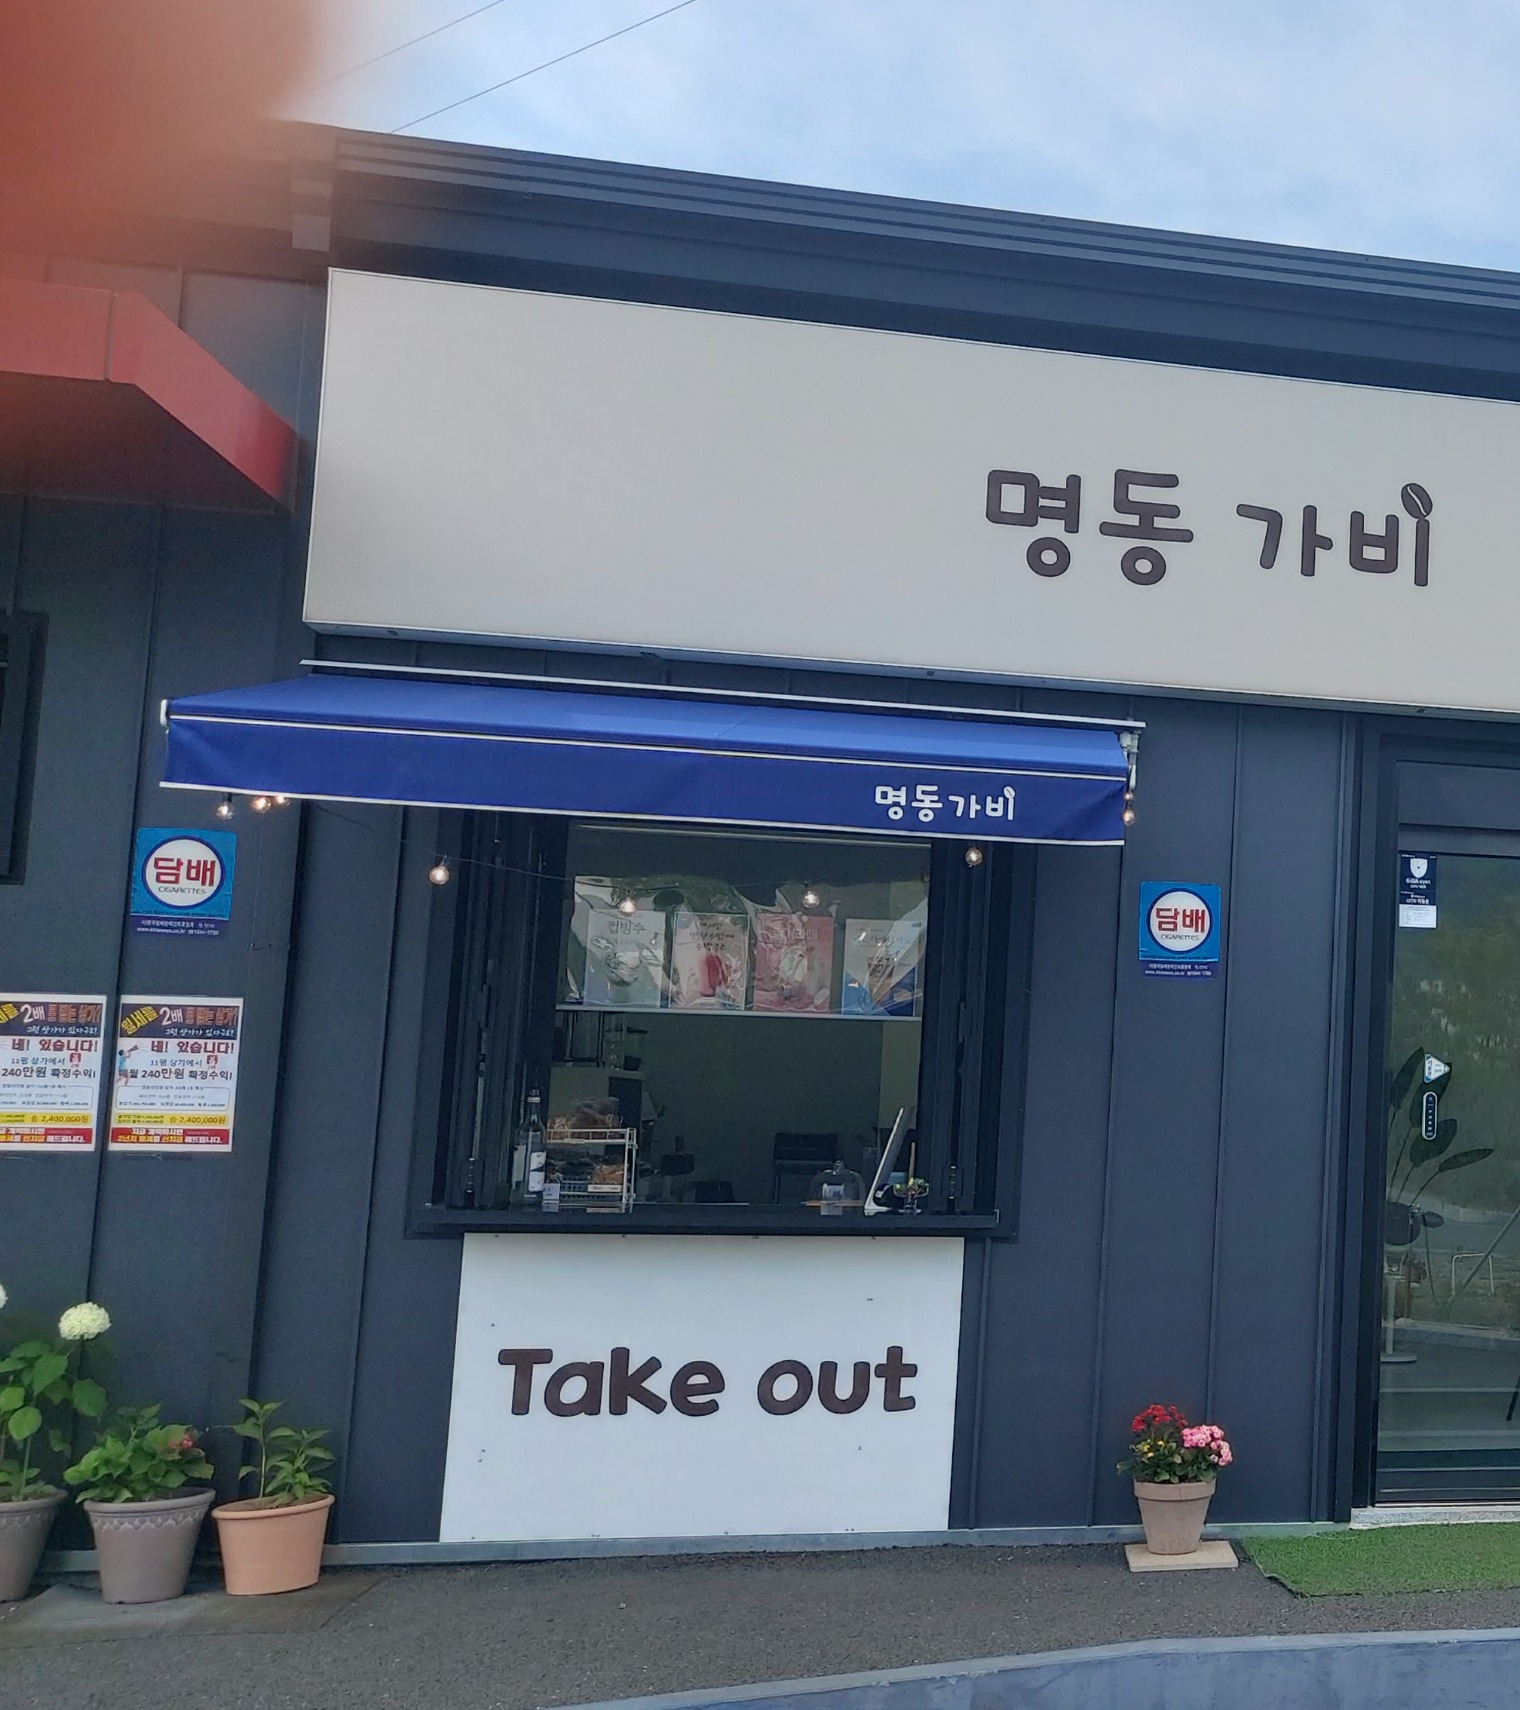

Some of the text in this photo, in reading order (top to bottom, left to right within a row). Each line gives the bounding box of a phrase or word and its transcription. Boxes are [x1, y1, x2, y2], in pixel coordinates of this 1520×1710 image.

[986, 469, 1433, 587] 명동 가비
[154, 857, 216, 887] 담배
[158, 886, 206, 895] CIGARETTES
[1156, 907, 1205, 933] 담배
[1160, 933, 1199, 941] CIGARETTES
[12, 1038, 98, 1053] 네! 있습니다!
[151, 1040, 235, 1054] 네! 있습니다!
[2, 1066, 47, 1078] 240만원
[141, 1067, 184, 1079] 240만원
[498, 1345, 918, 1418] Take out
